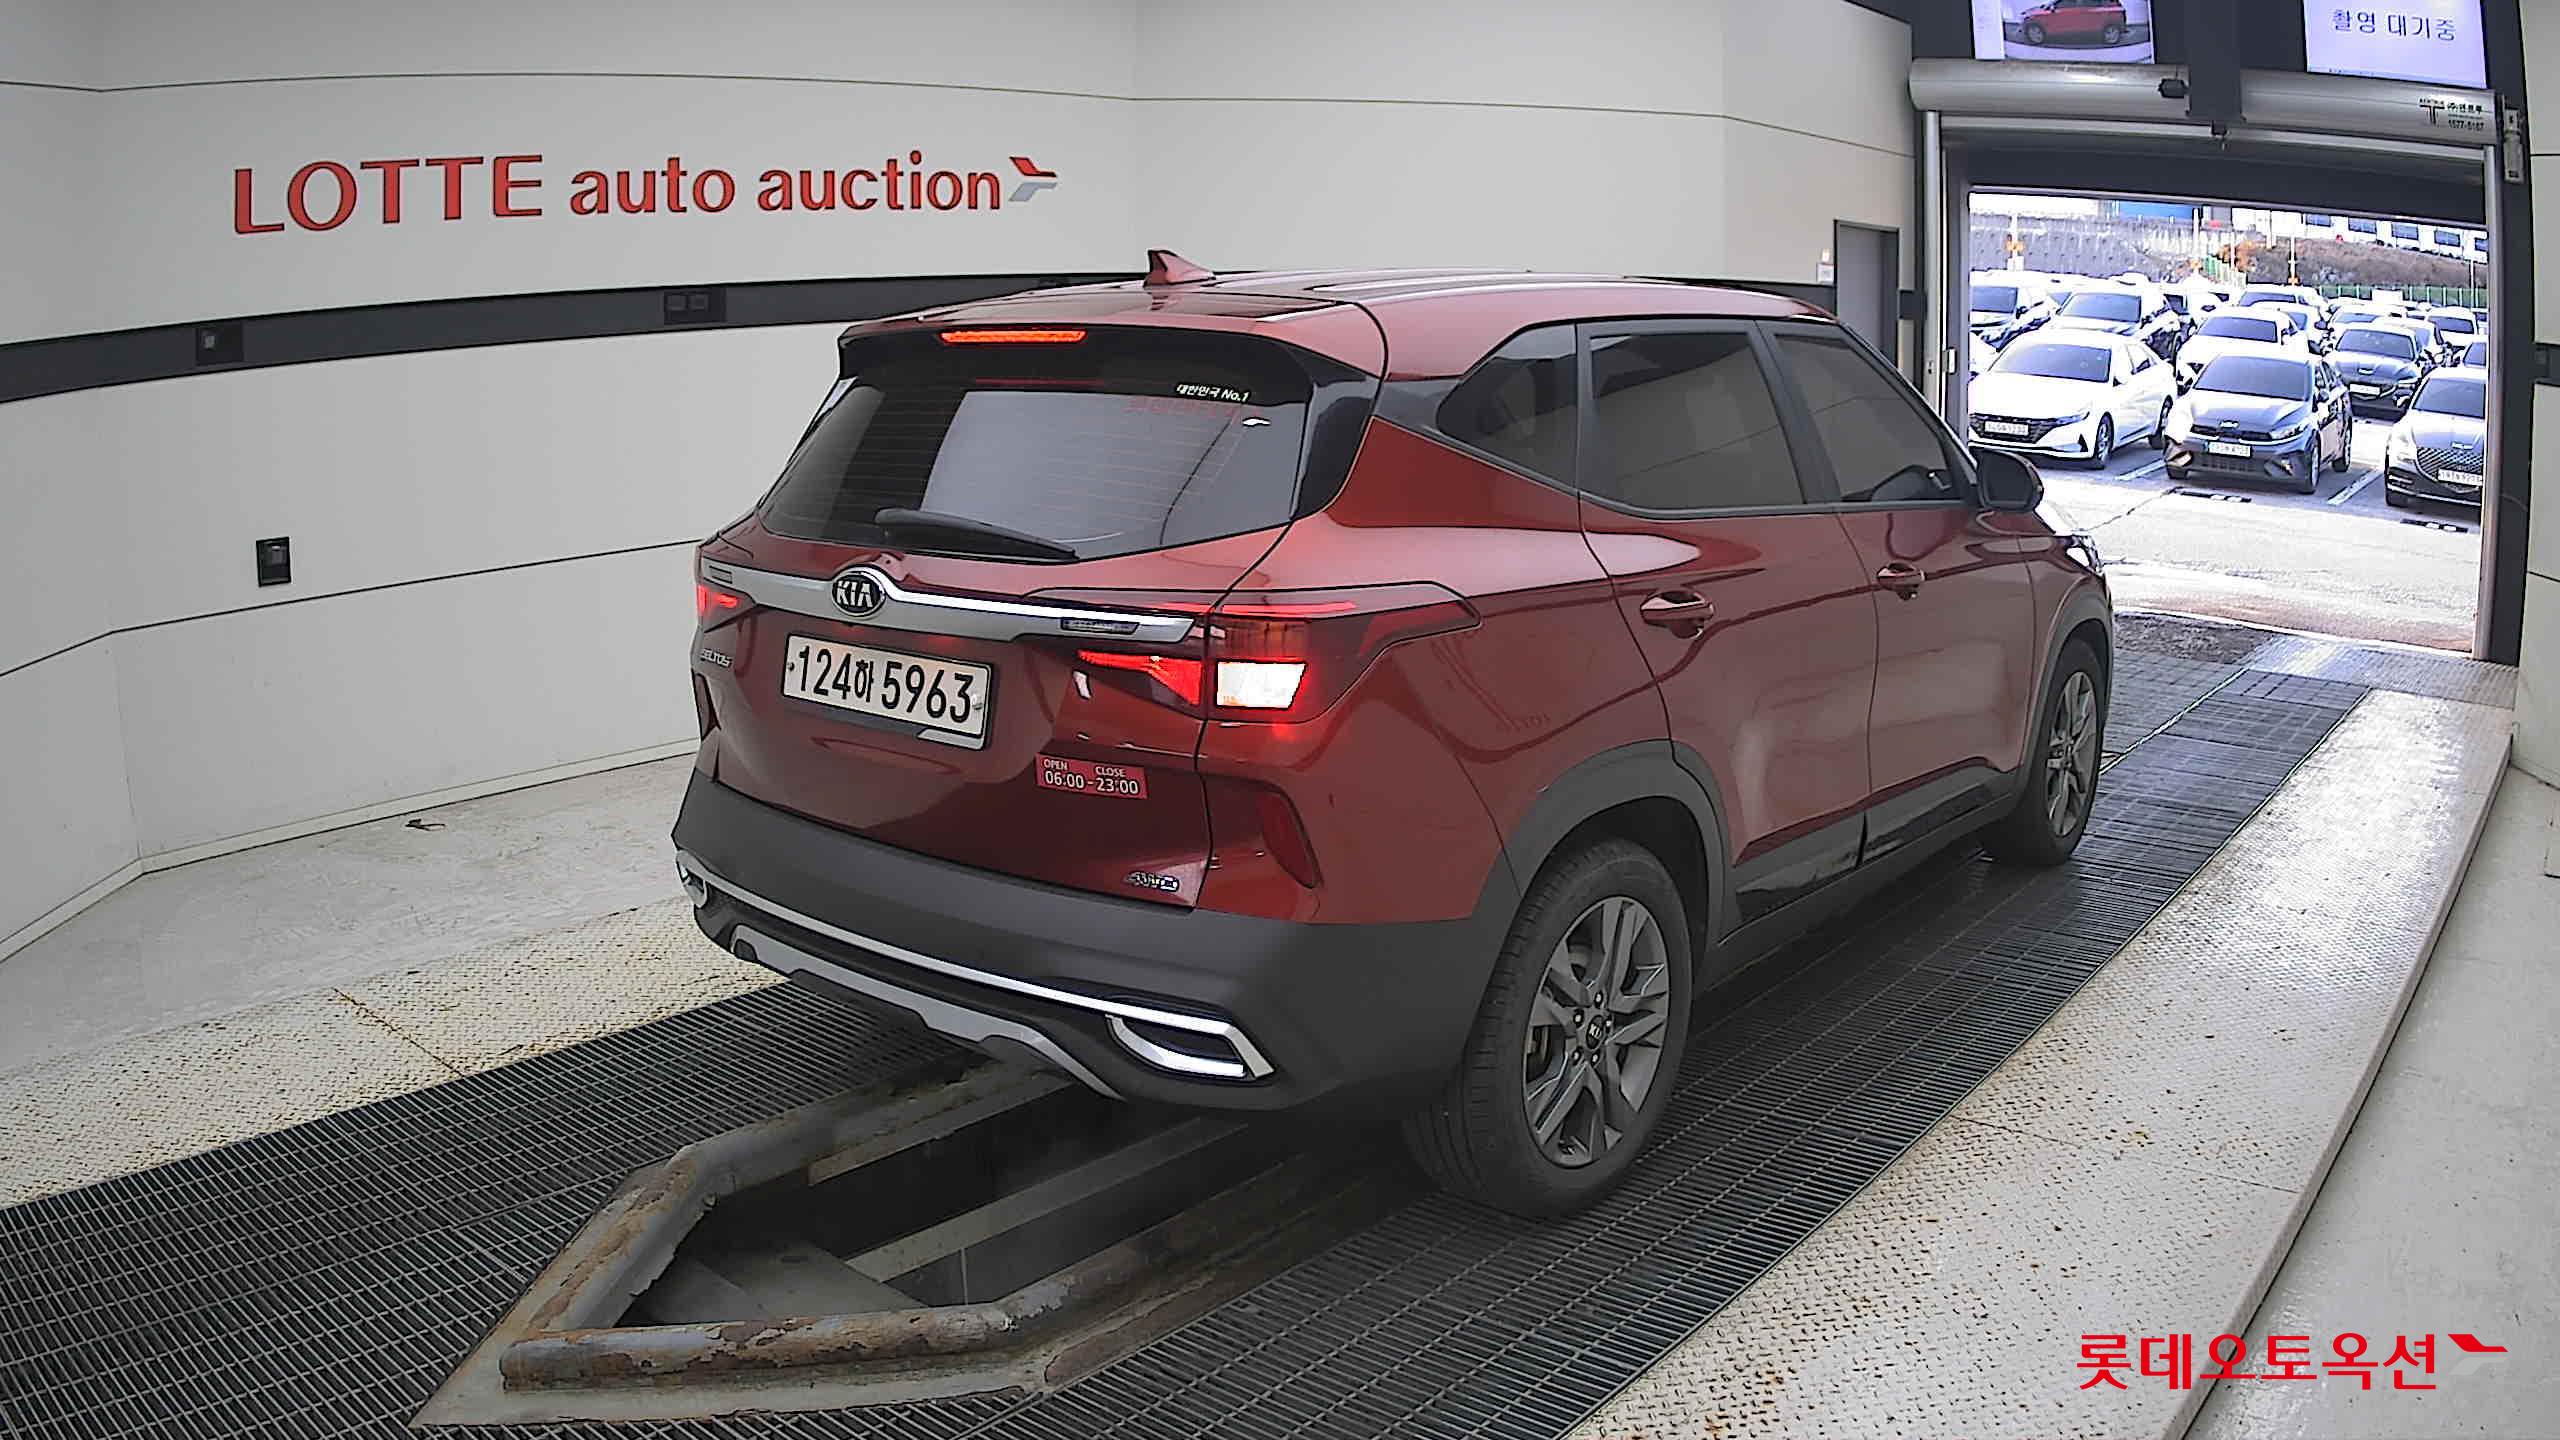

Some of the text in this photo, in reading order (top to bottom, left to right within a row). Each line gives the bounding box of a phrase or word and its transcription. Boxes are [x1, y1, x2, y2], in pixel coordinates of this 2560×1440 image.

[2333, 9, 2455, 42] 촬영 대기중
[235, 151, 1002, 234] LOTTE auto auction
[1176, 384, 1250, 403] 대한민국 No.1
[837, 580, 873, 608] KIA
[881, 660, 974, 724] 5963
[1043, 758, 1127, 778] OPEN CLOSE
